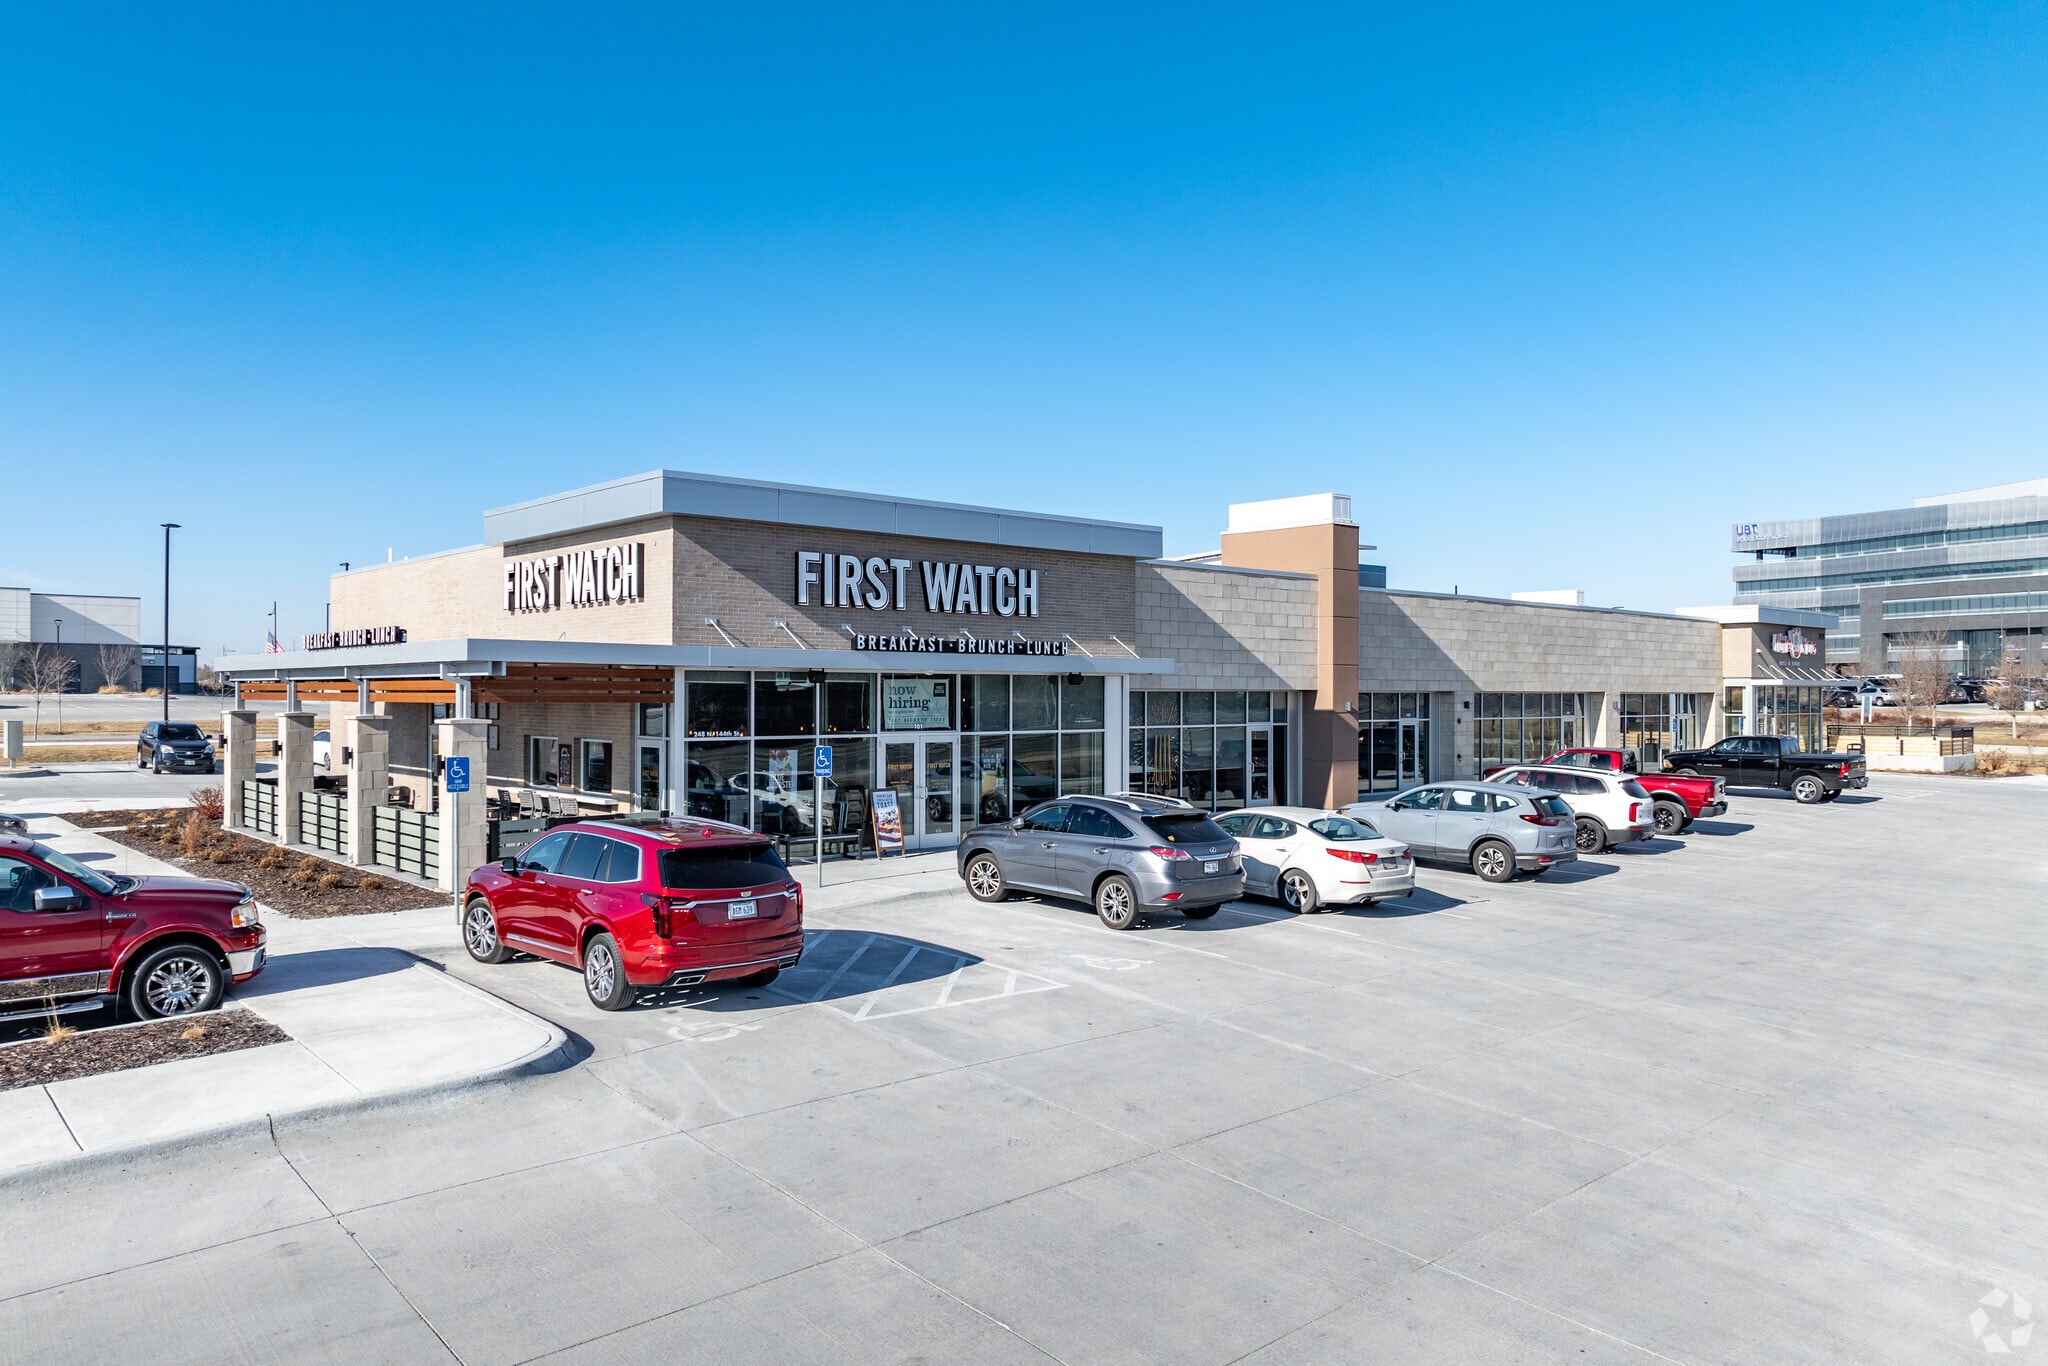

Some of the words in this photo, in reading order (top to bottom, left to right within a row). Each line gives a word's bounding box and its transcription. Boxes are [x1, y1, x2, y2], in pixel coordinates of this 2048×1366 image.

[1736, 523, 1758, 536] UBT
[503, 555, 559, 611] FIRST
[563, 542, 644, 606] WATCH
[795, 550, 912, 612] FIRST
[920, 560, 1040, 618] WATCH
[339, 629, 367, 647] BRUNCH
[371, 626, 396, 643] LUNCH
[856, 633, 944, 653] BREAKFAST
[957, 637, 1015, 655] BRUNCH
[1026, 640, 1069, 656] LUNCH
[889, 686, 917, 696] now
[888, 697, 929, 712] hiring
